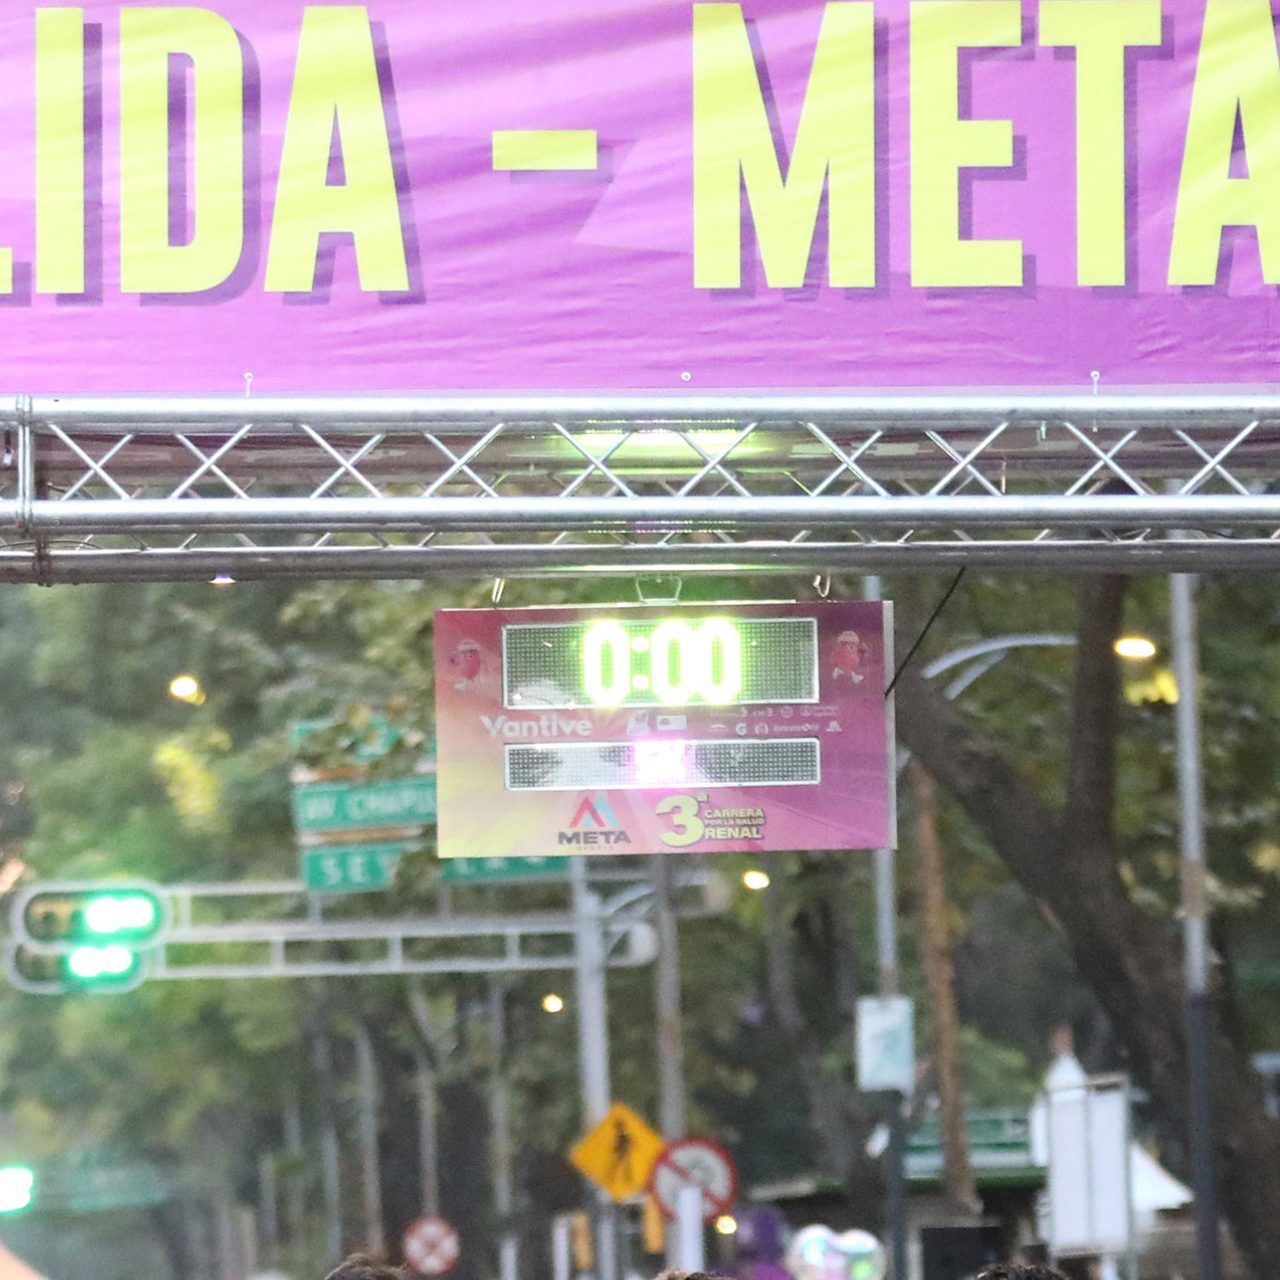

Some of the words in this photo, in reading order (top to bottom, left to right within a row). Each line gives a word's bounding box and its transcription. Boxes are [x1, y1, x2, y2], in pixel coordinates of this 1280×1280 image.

[692, 0, 1280, 289] META
[582, 617, 743, 704] 0:00
[480, 714, 593, 737] Vantive
[704, 808, 764, 819] CARRERA
[558, 831, 632, 845] META
[704, 827, 763, 840] RENAL
